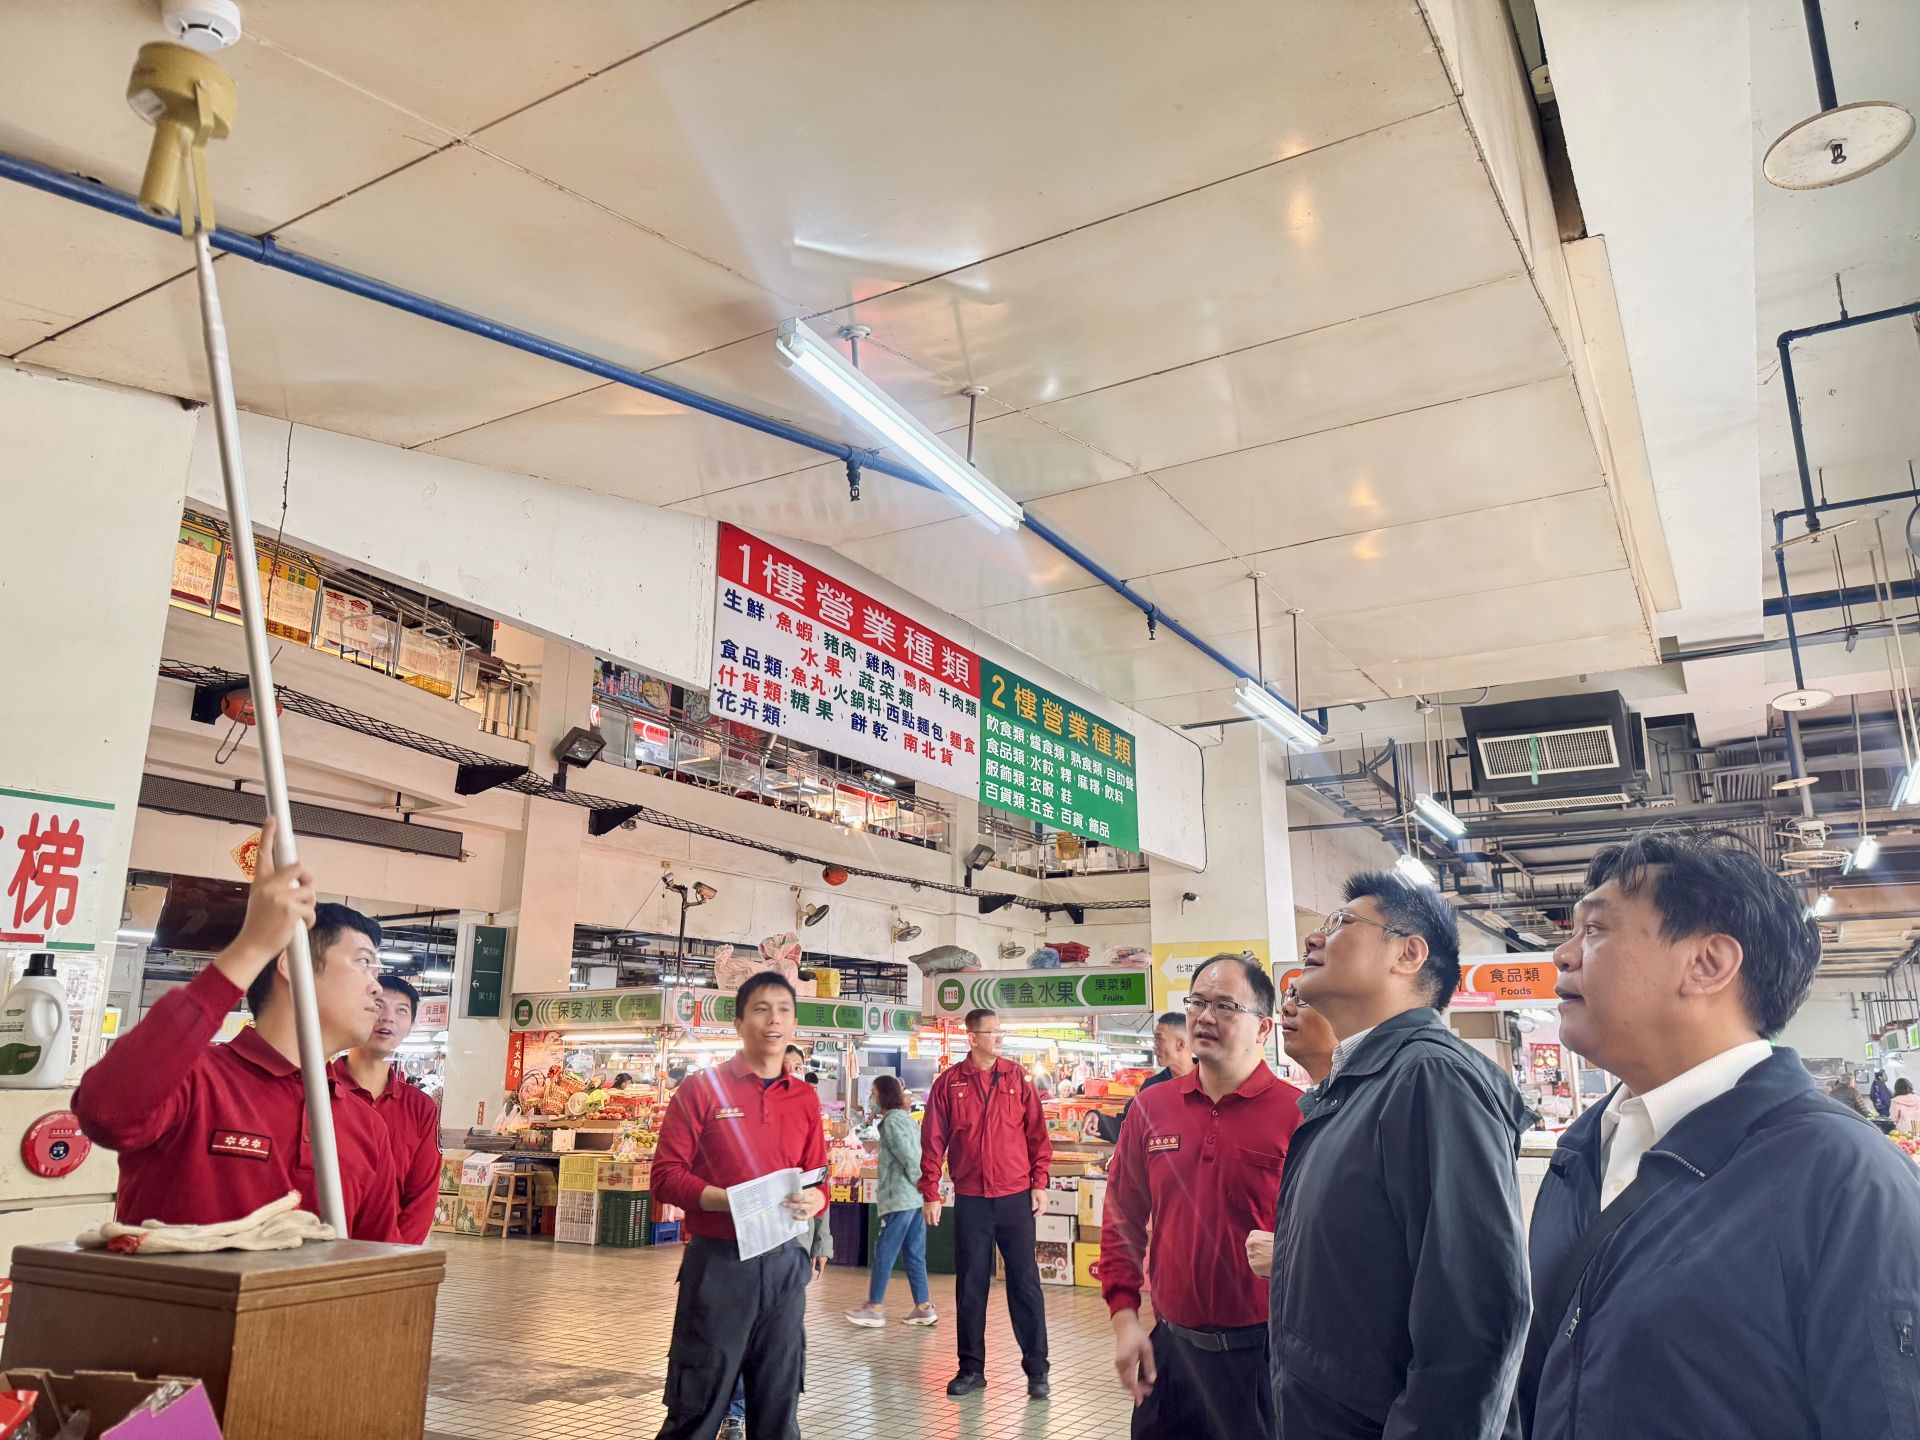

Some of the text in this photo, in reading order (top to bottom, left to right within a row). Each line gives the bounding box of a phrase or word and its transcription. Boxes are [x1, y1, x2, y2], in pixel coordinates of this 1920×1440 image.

[739, 543, 970, 689] 1樓營業種類
[991, 674, 1131, 768] 2樓營業種類
[0, 812, 84, 930] 梯
[1095, 978, 1132, 991] 果菜類
[1489, 967, 1541, 984] 食品類
[1000, 981, 1075, 1004] 禮盒水果
[1102, 994, 1124, 1002] Fruits
[1501, 987, 1532, 996] Foods
[558, 1000, 613, 1020] 保安水果
